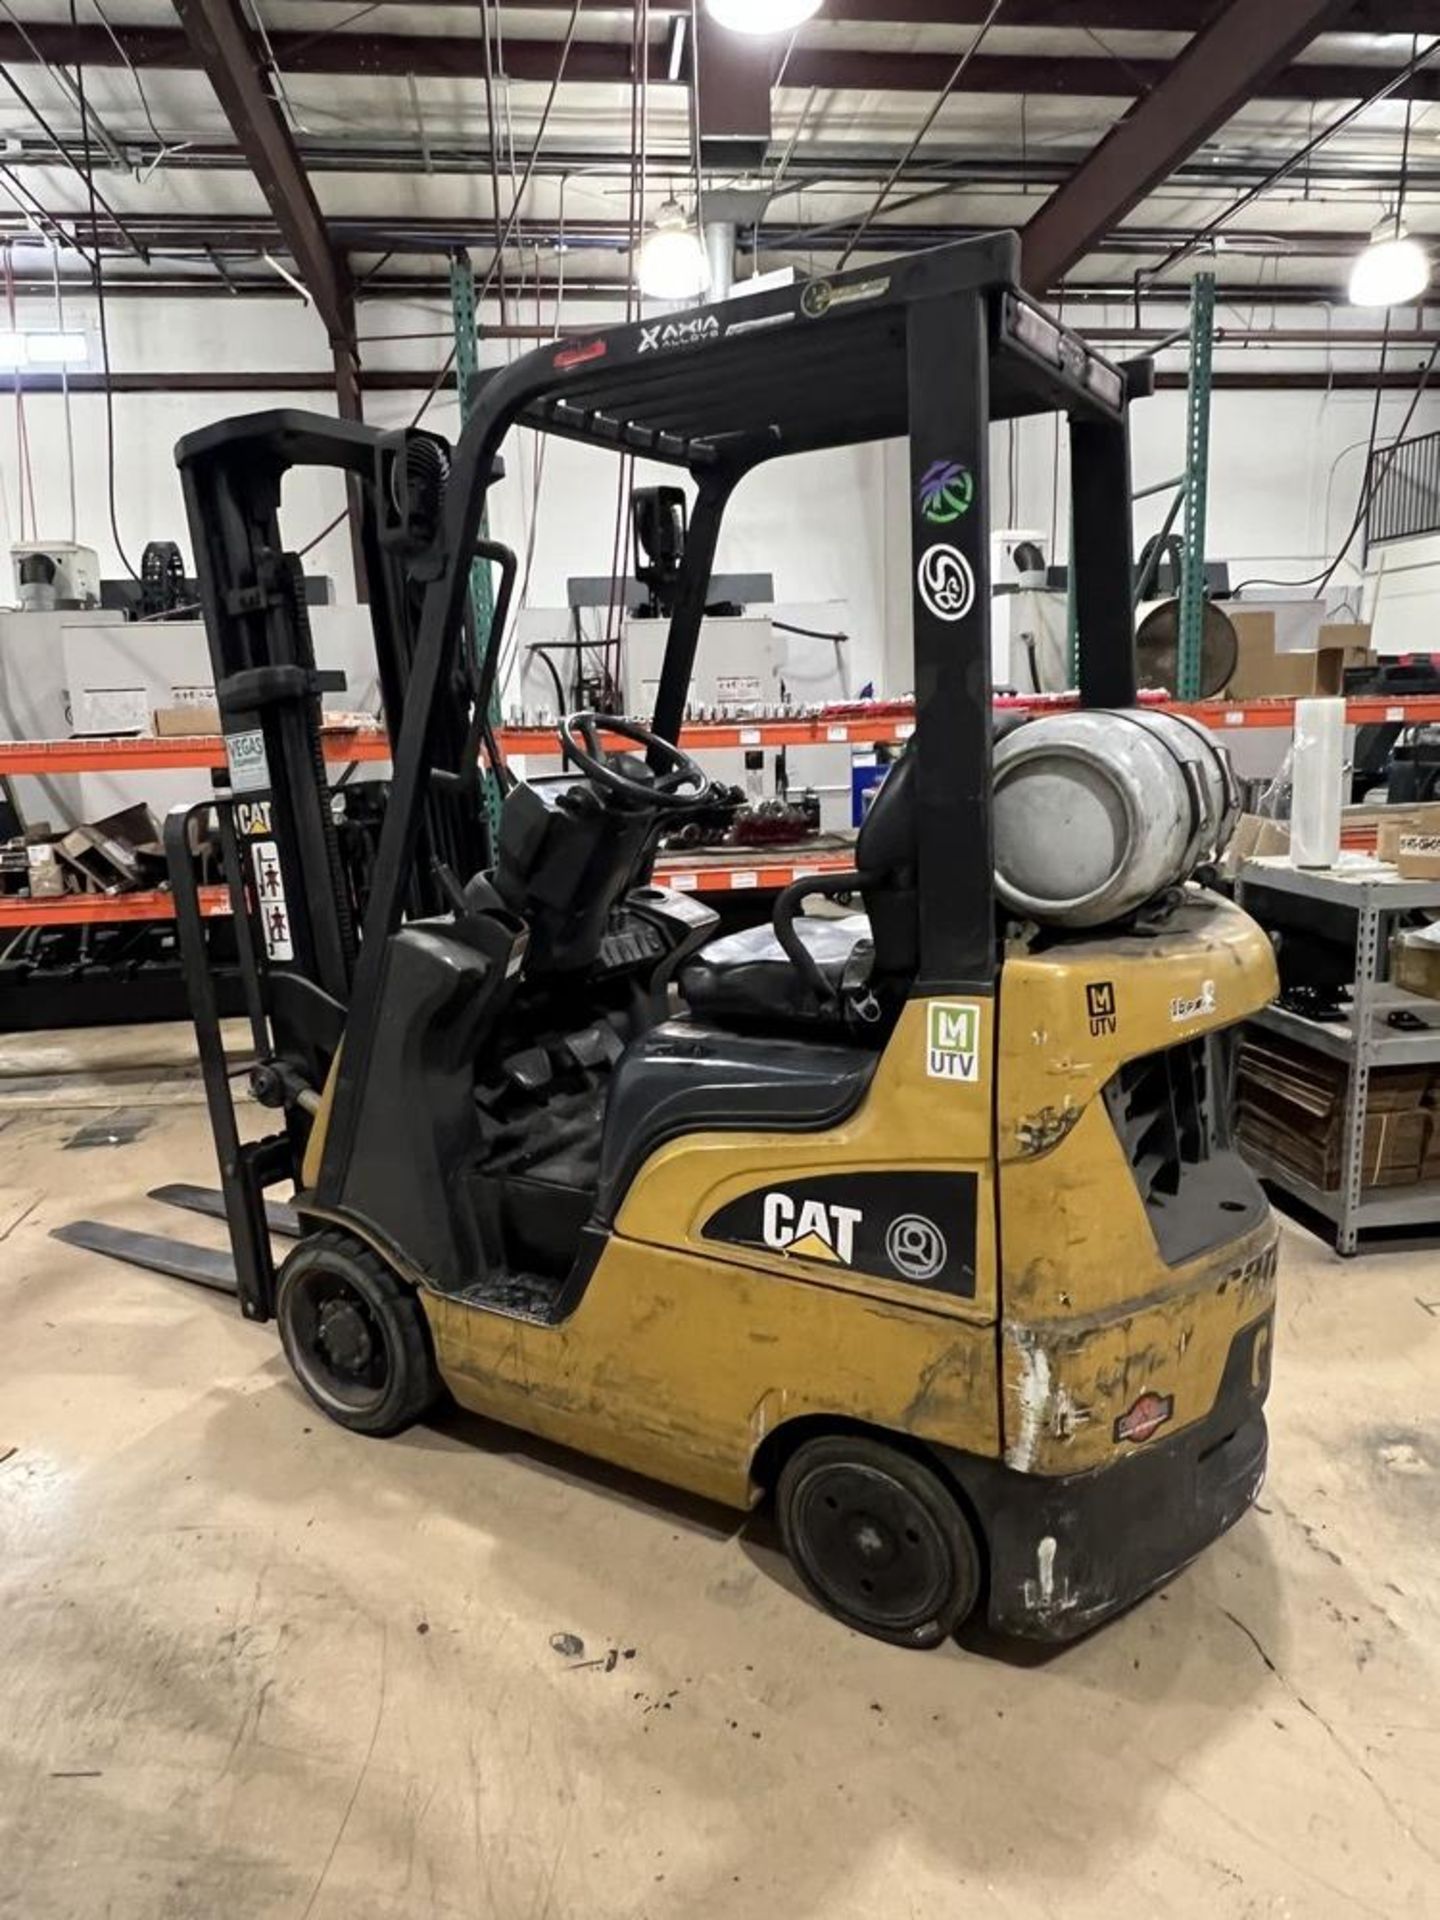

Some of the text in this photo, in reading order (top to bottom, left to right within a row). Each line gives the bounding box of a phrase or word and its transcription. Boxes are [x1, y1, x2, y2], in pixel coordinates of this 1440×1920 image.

[661, 315, 719, 340] AXIA
[229, 736, 264, 757] VEGAS
[237, 801, 272, 834] CAT
[1089, 1016, 1117, 1038] UTV
[930, 1050, 974, 1077] UTV
[763, 1192, 863, 1264] CAT
